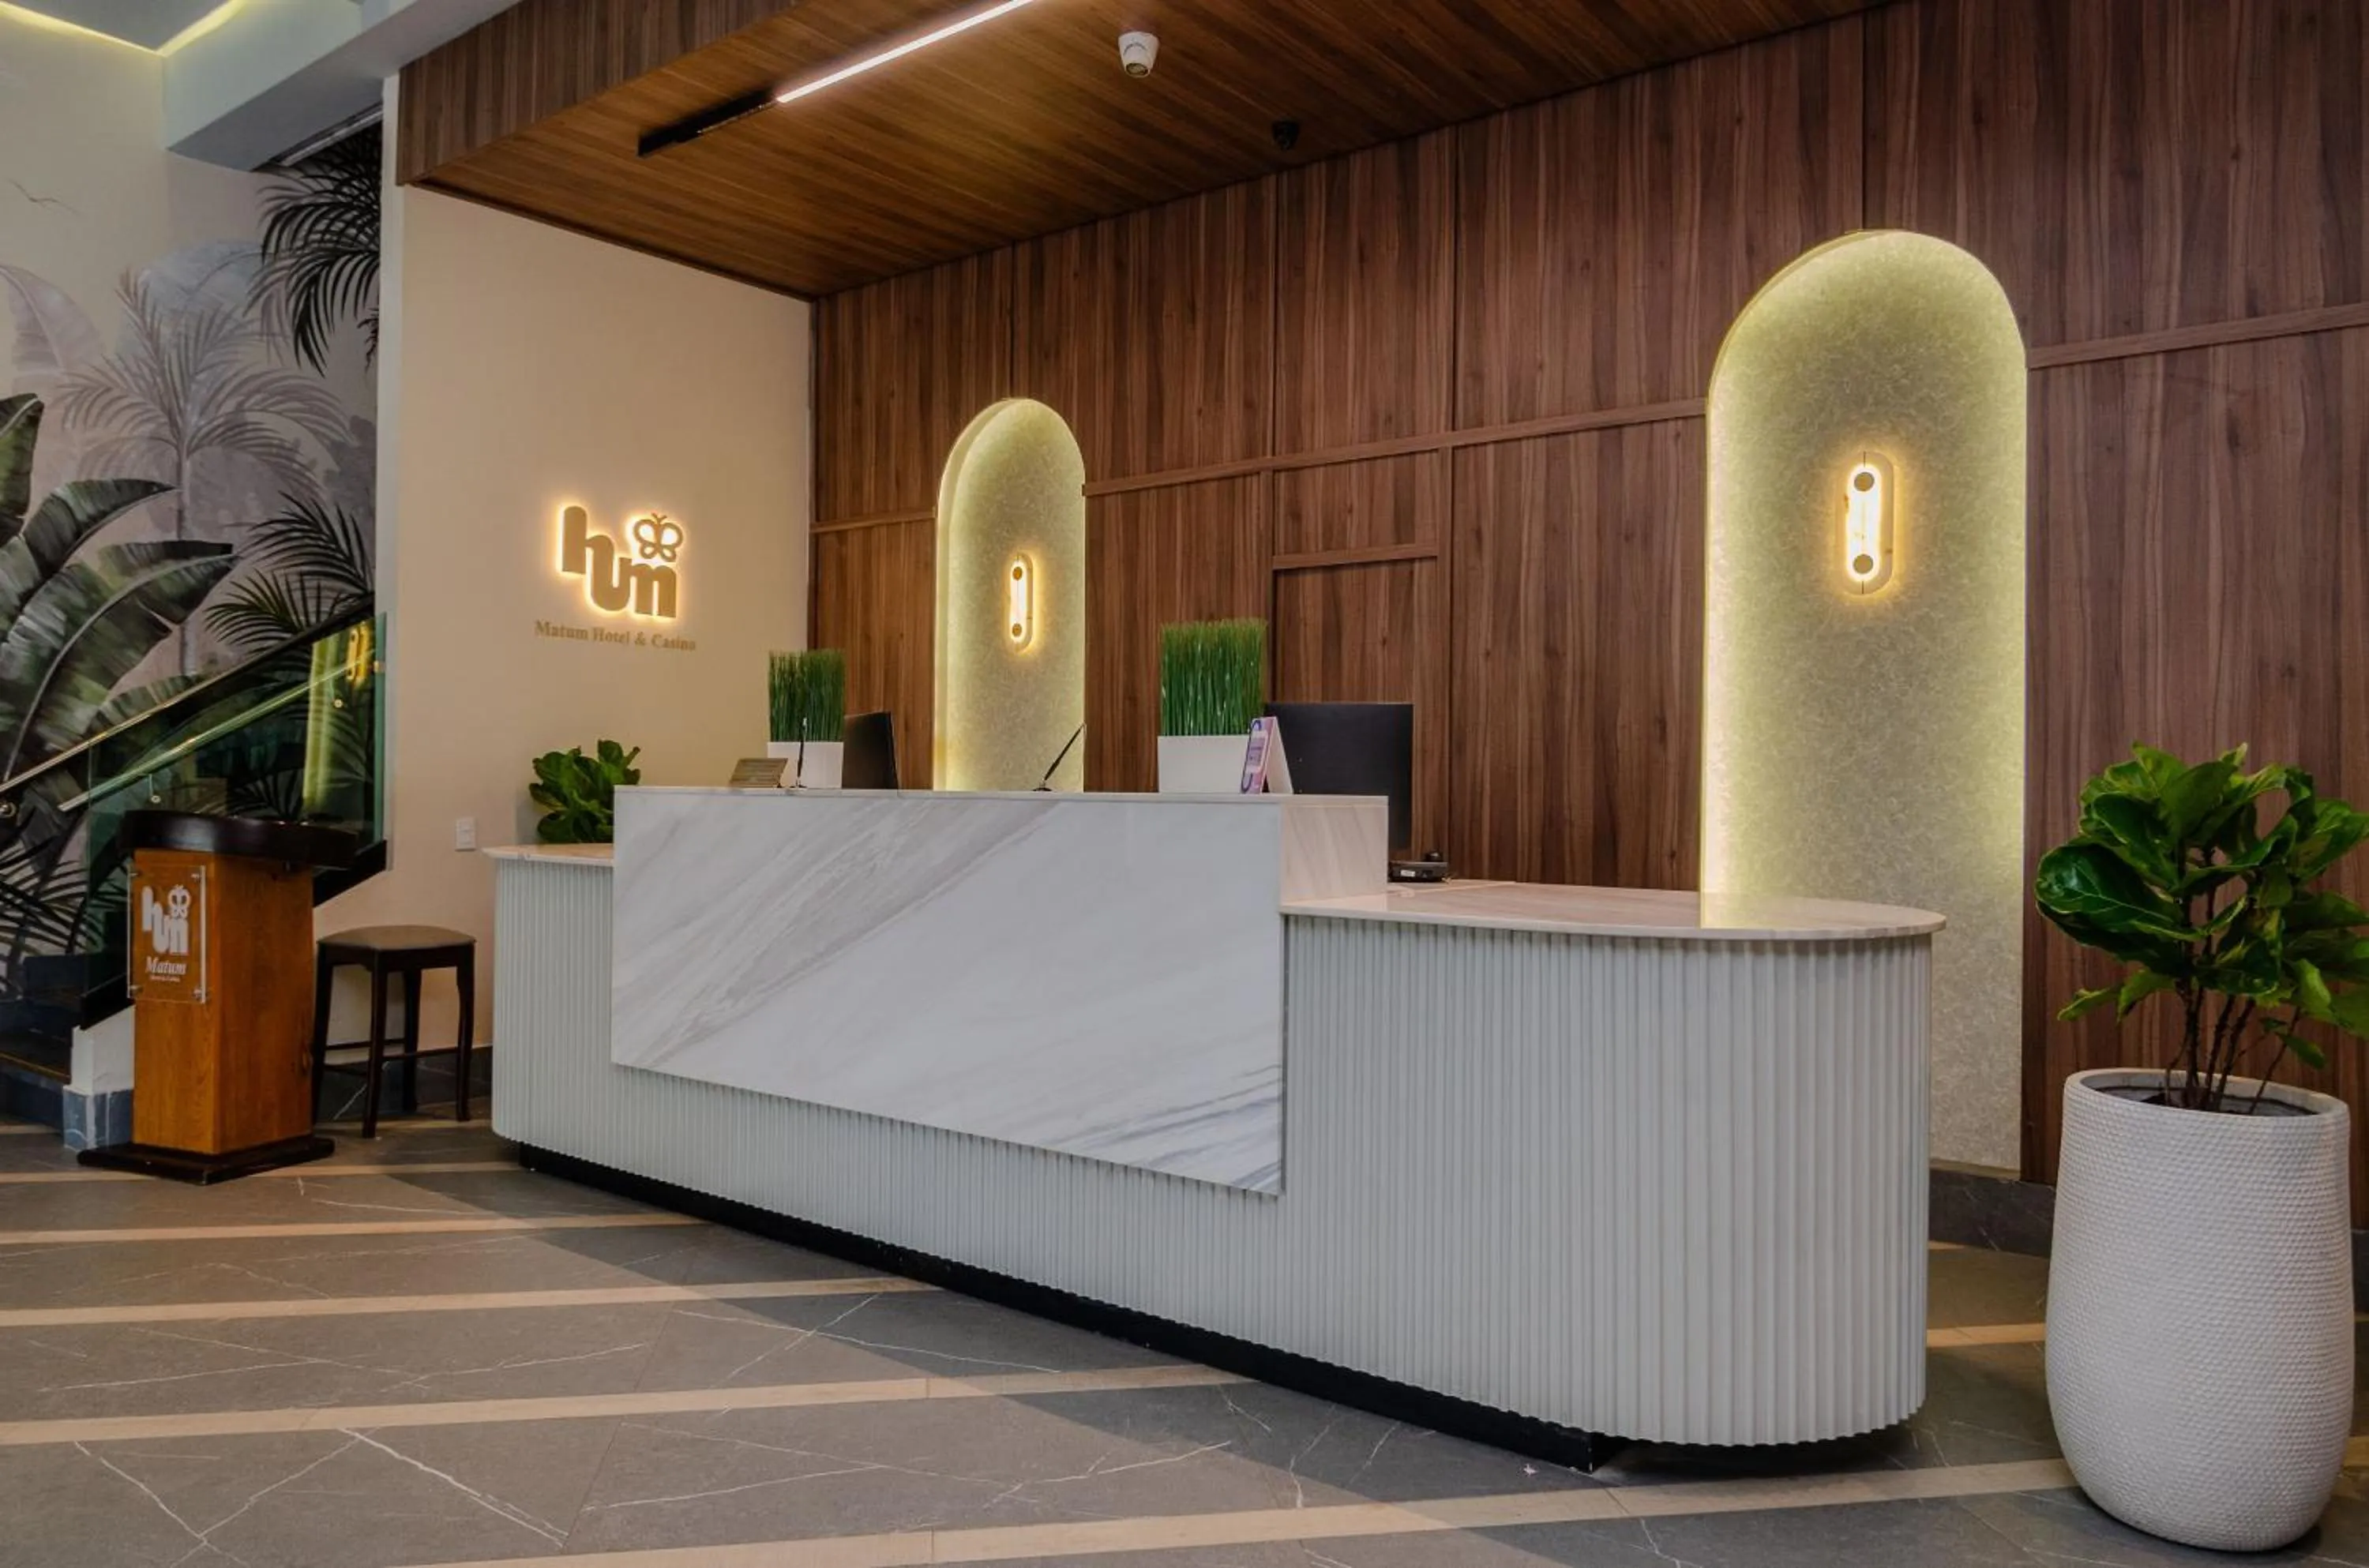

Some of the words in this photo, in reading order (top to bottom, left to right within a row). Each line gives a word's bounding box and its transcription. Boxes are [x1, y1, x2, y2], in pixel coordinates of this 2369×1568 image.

[535, 620, 588, 641] Matum
[592, 626, 630, 645] Hotel
[634, 632, 646, 647] &
[651, 633, 696, 651] Casino
[145, 955, 187, 975] Matum
